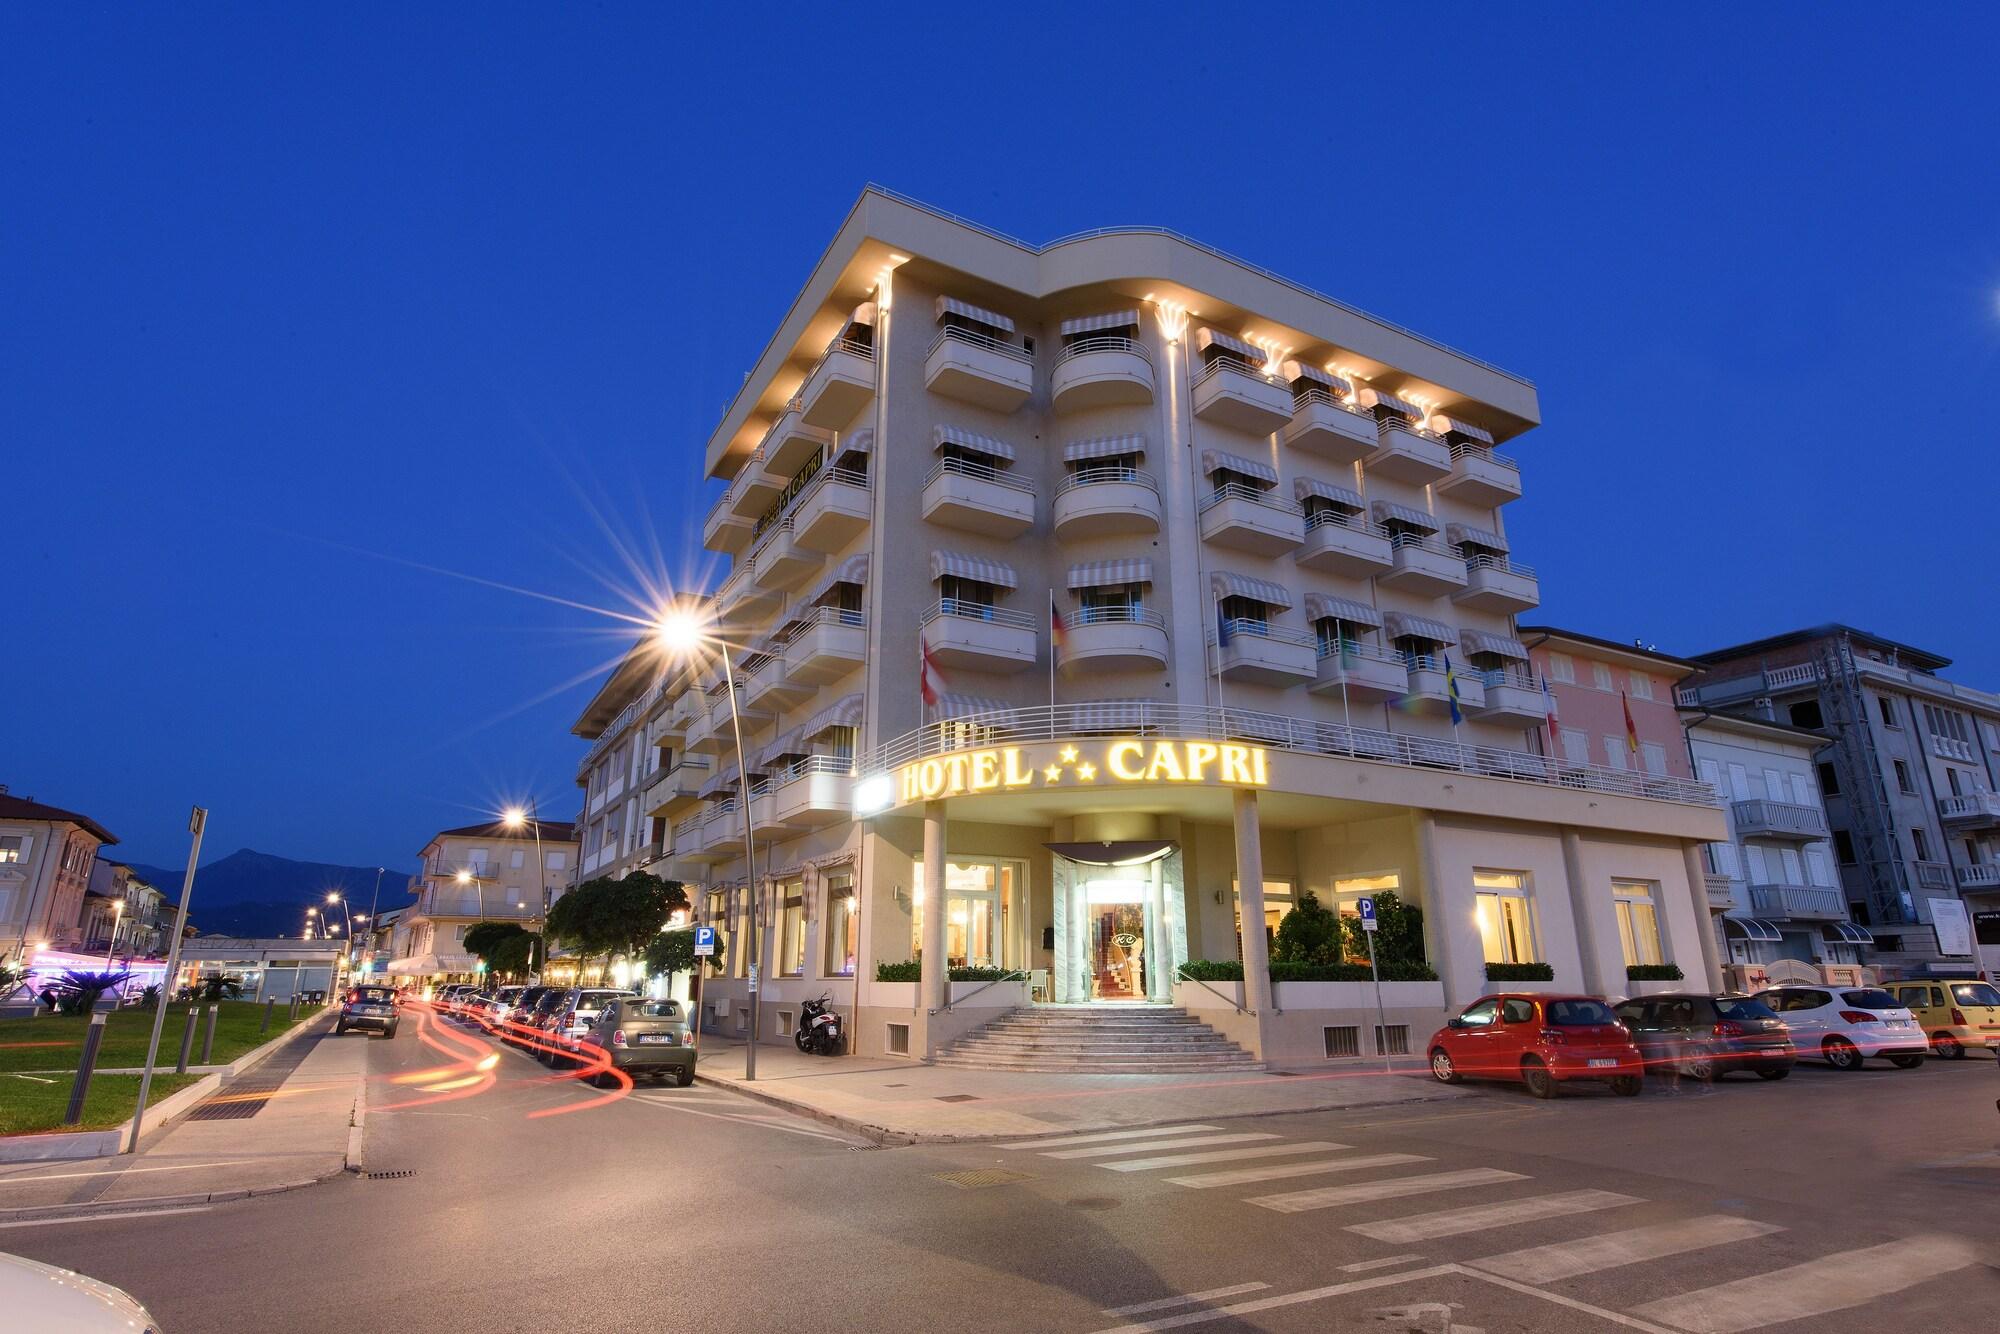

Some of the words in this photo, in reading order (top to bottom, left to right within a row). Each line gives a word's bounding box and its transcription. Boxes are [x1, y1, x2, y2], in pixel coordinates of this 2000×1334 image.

[791, 453, 822, 494] CAPRI
[903, 748, 1033, 800] HOTEL
[1108, 740, 1267, 785] CAPRI
[1362, 899, 1371, 918] P
[698, 928, 711, 944] P
